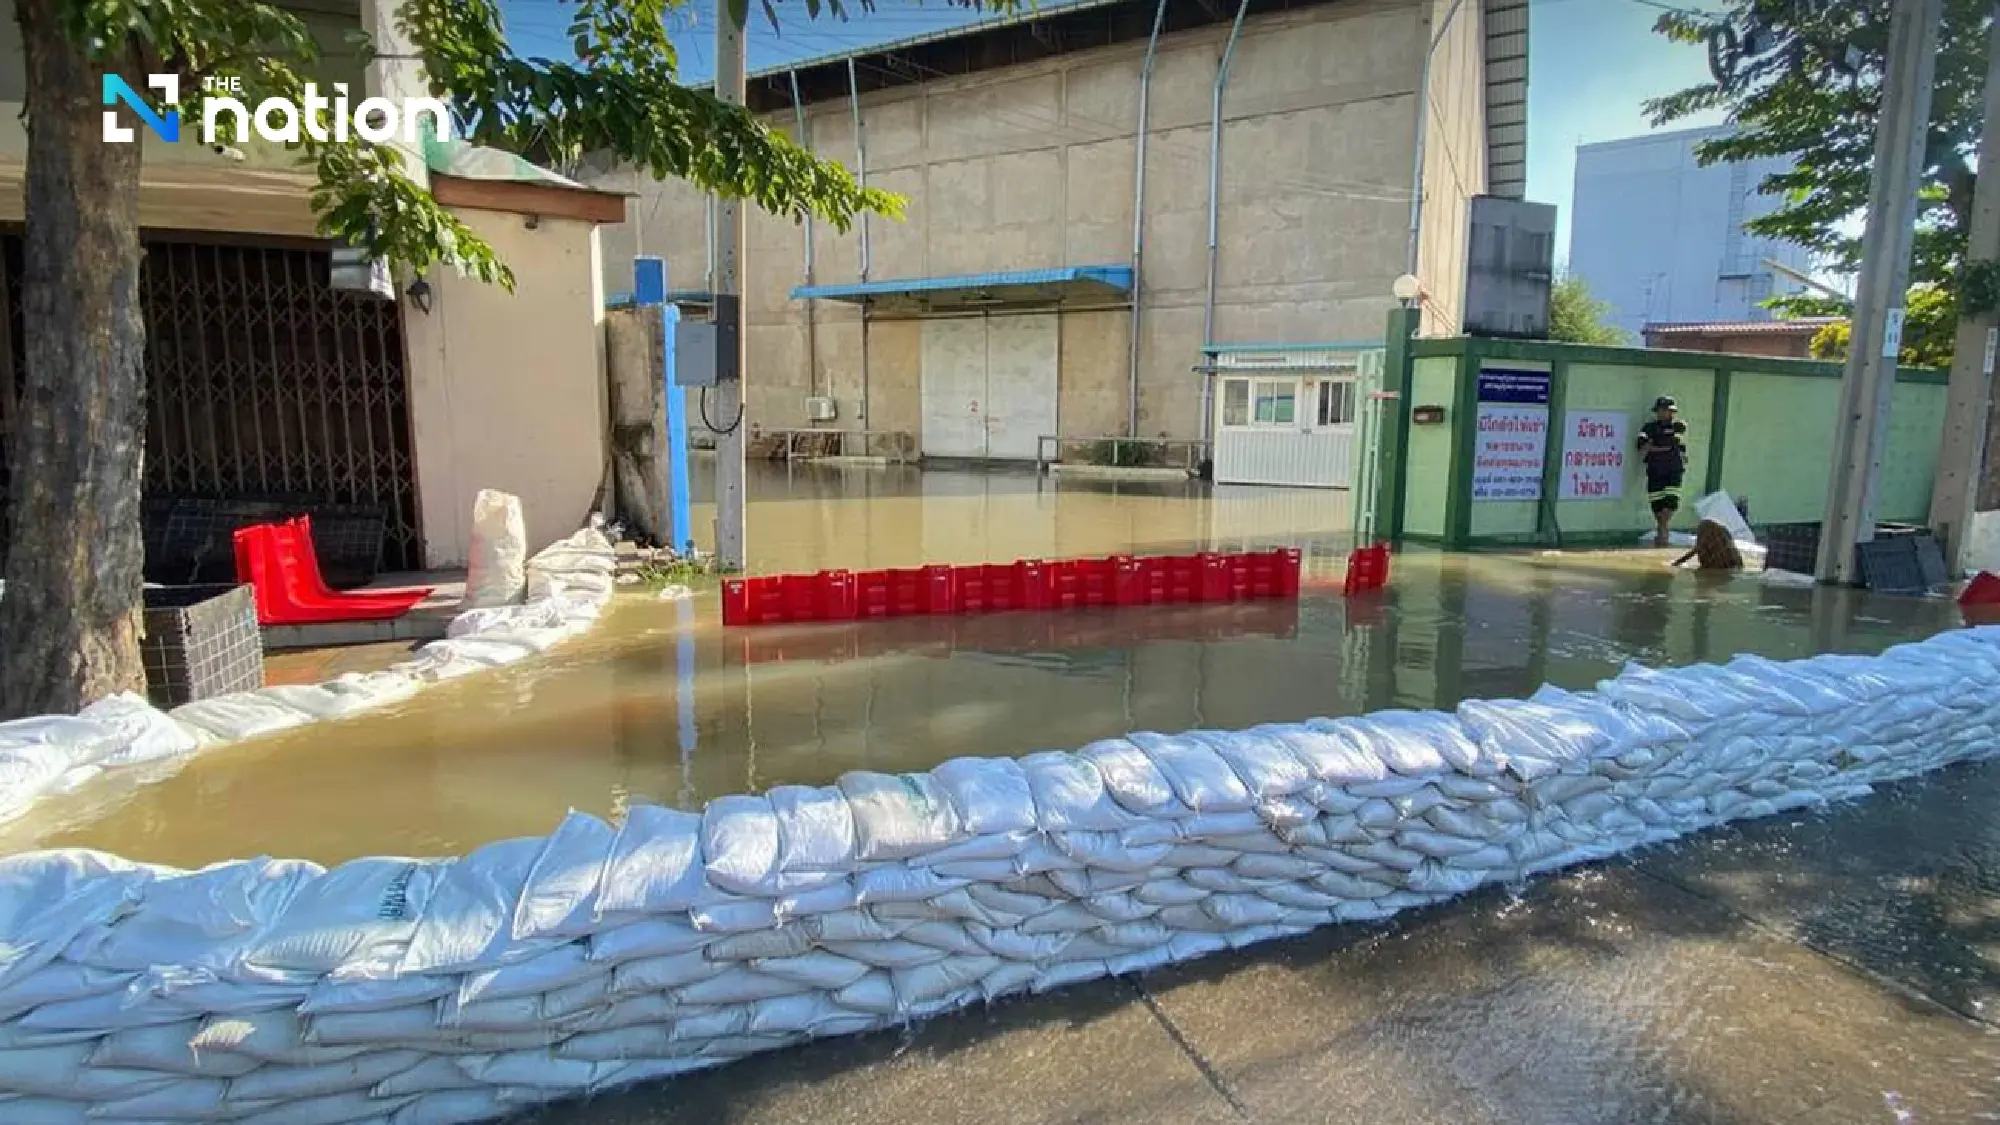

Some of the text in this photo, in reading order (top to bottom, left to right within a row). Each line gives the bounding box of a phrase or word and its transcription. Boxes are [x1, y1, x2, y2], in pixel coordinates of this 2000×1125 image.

[1577, 417, 1614, 438] มีลาน
[1572, 472, 1610, 495] ให้เช่า
